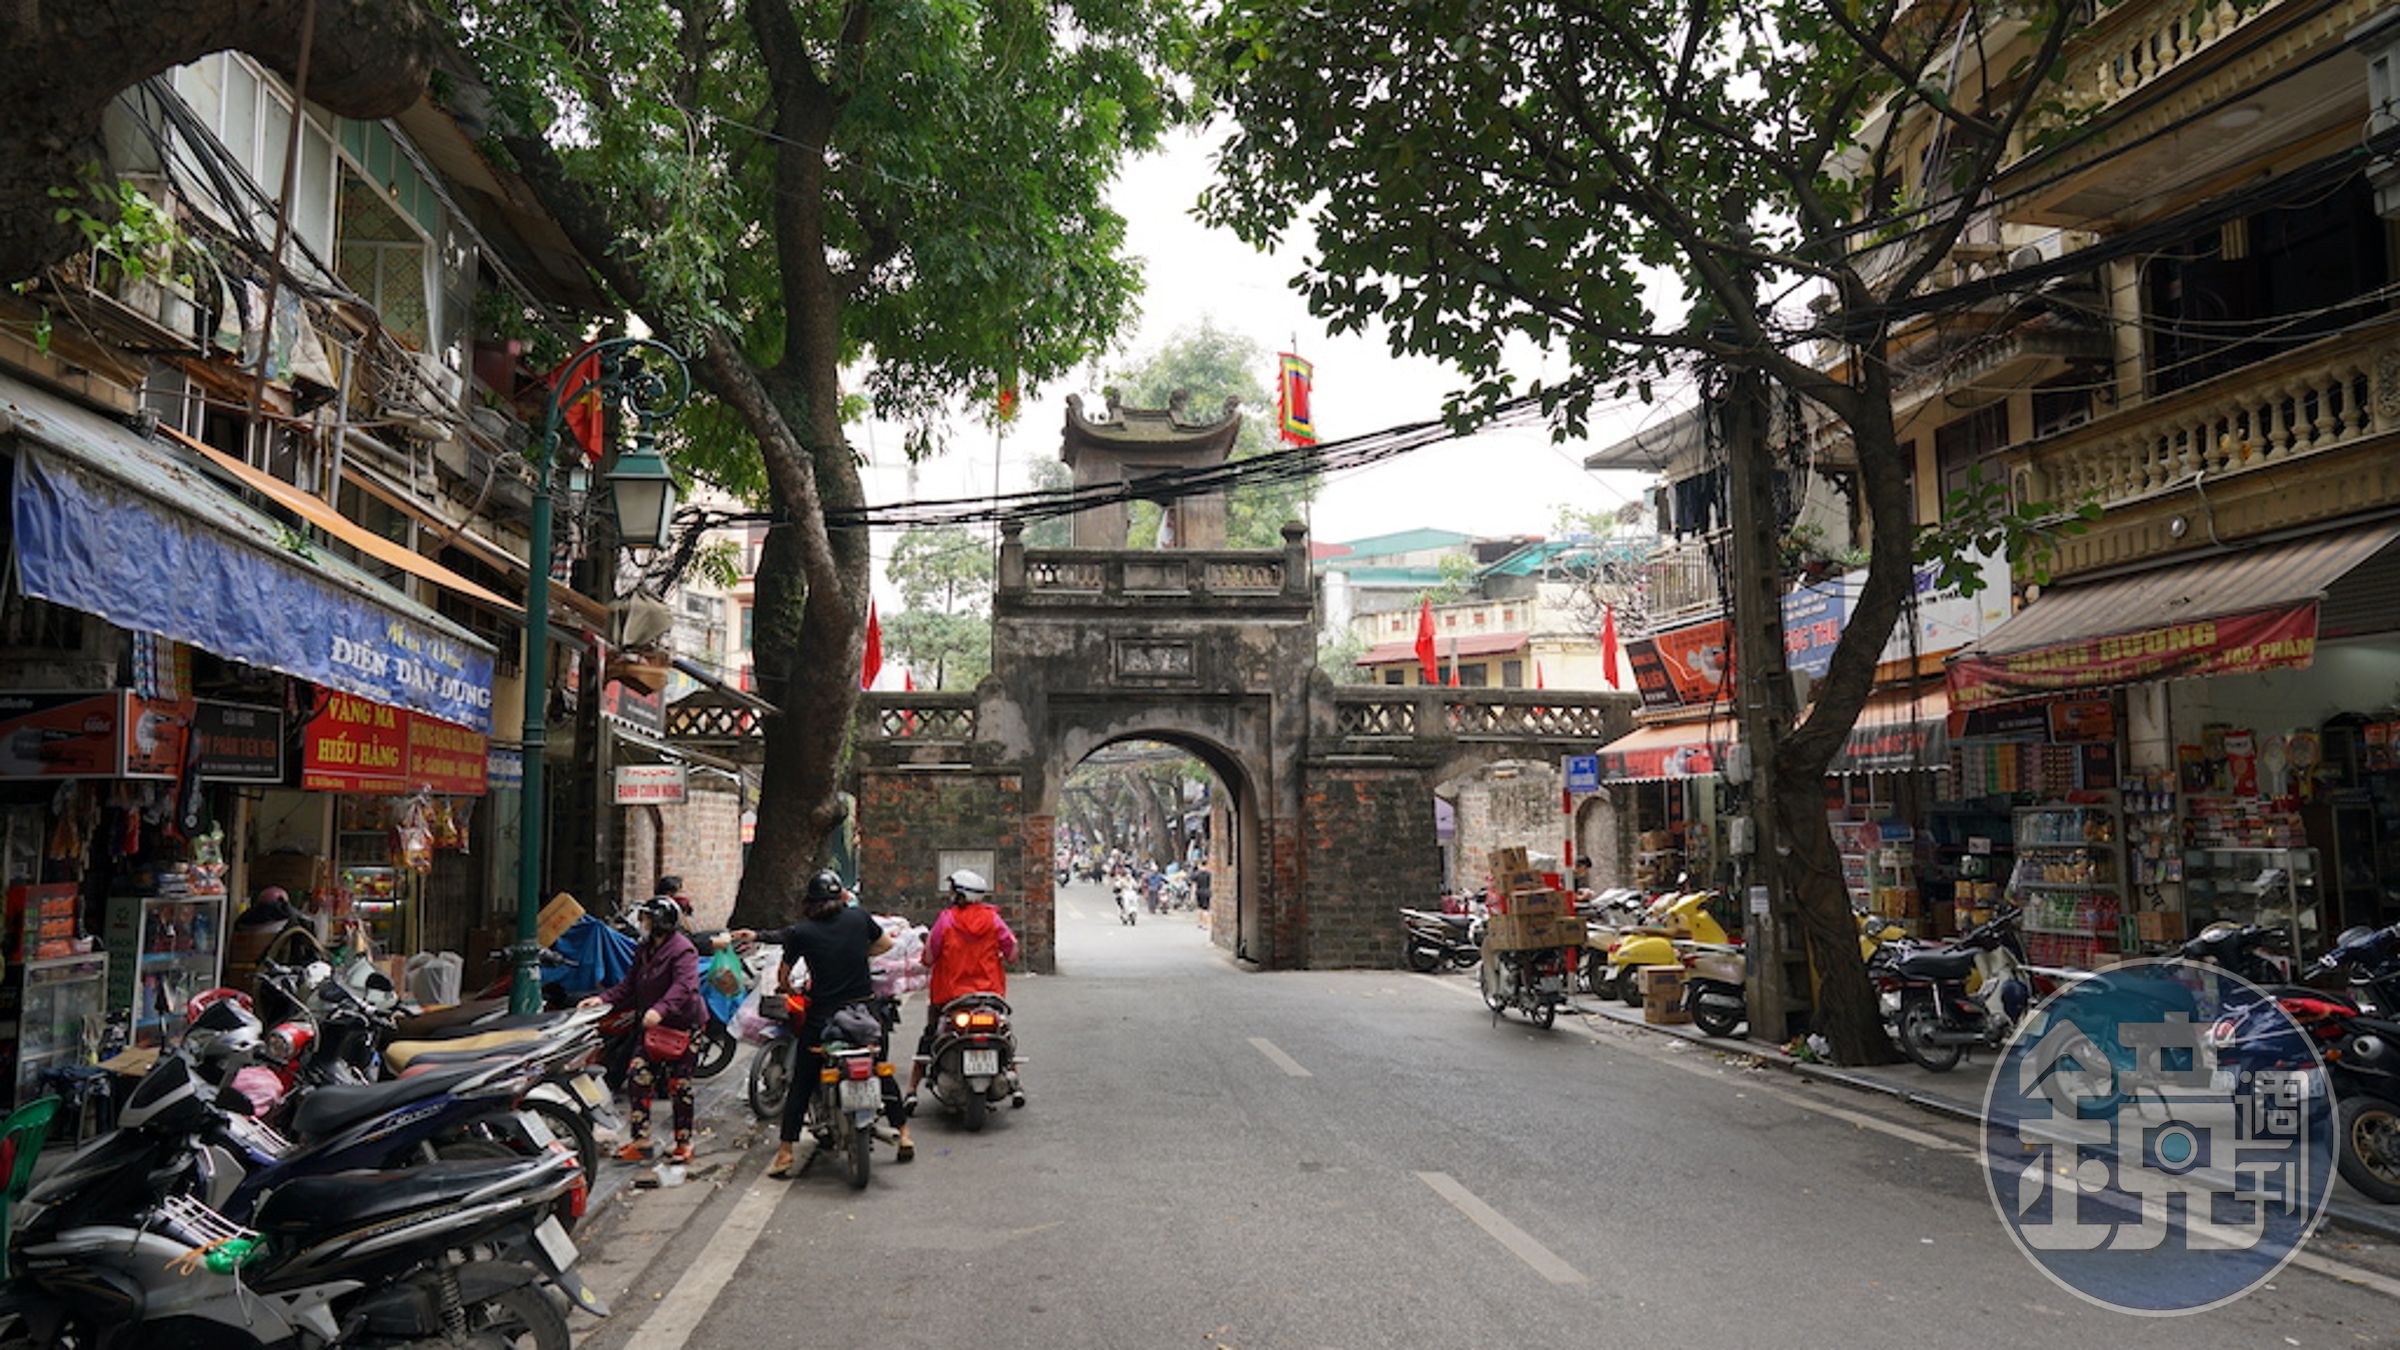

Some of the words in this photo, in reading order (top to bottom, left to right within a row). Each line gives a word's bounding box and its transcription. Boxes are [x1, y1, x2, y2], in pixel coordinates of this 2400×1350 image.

[331, 634, 389, 679] ĐIỆN
[440, 677, 492, 711] DỤNG
[328, 692, 371, 725] VÀNG
[317, 731, 358, 765] HIẾU
